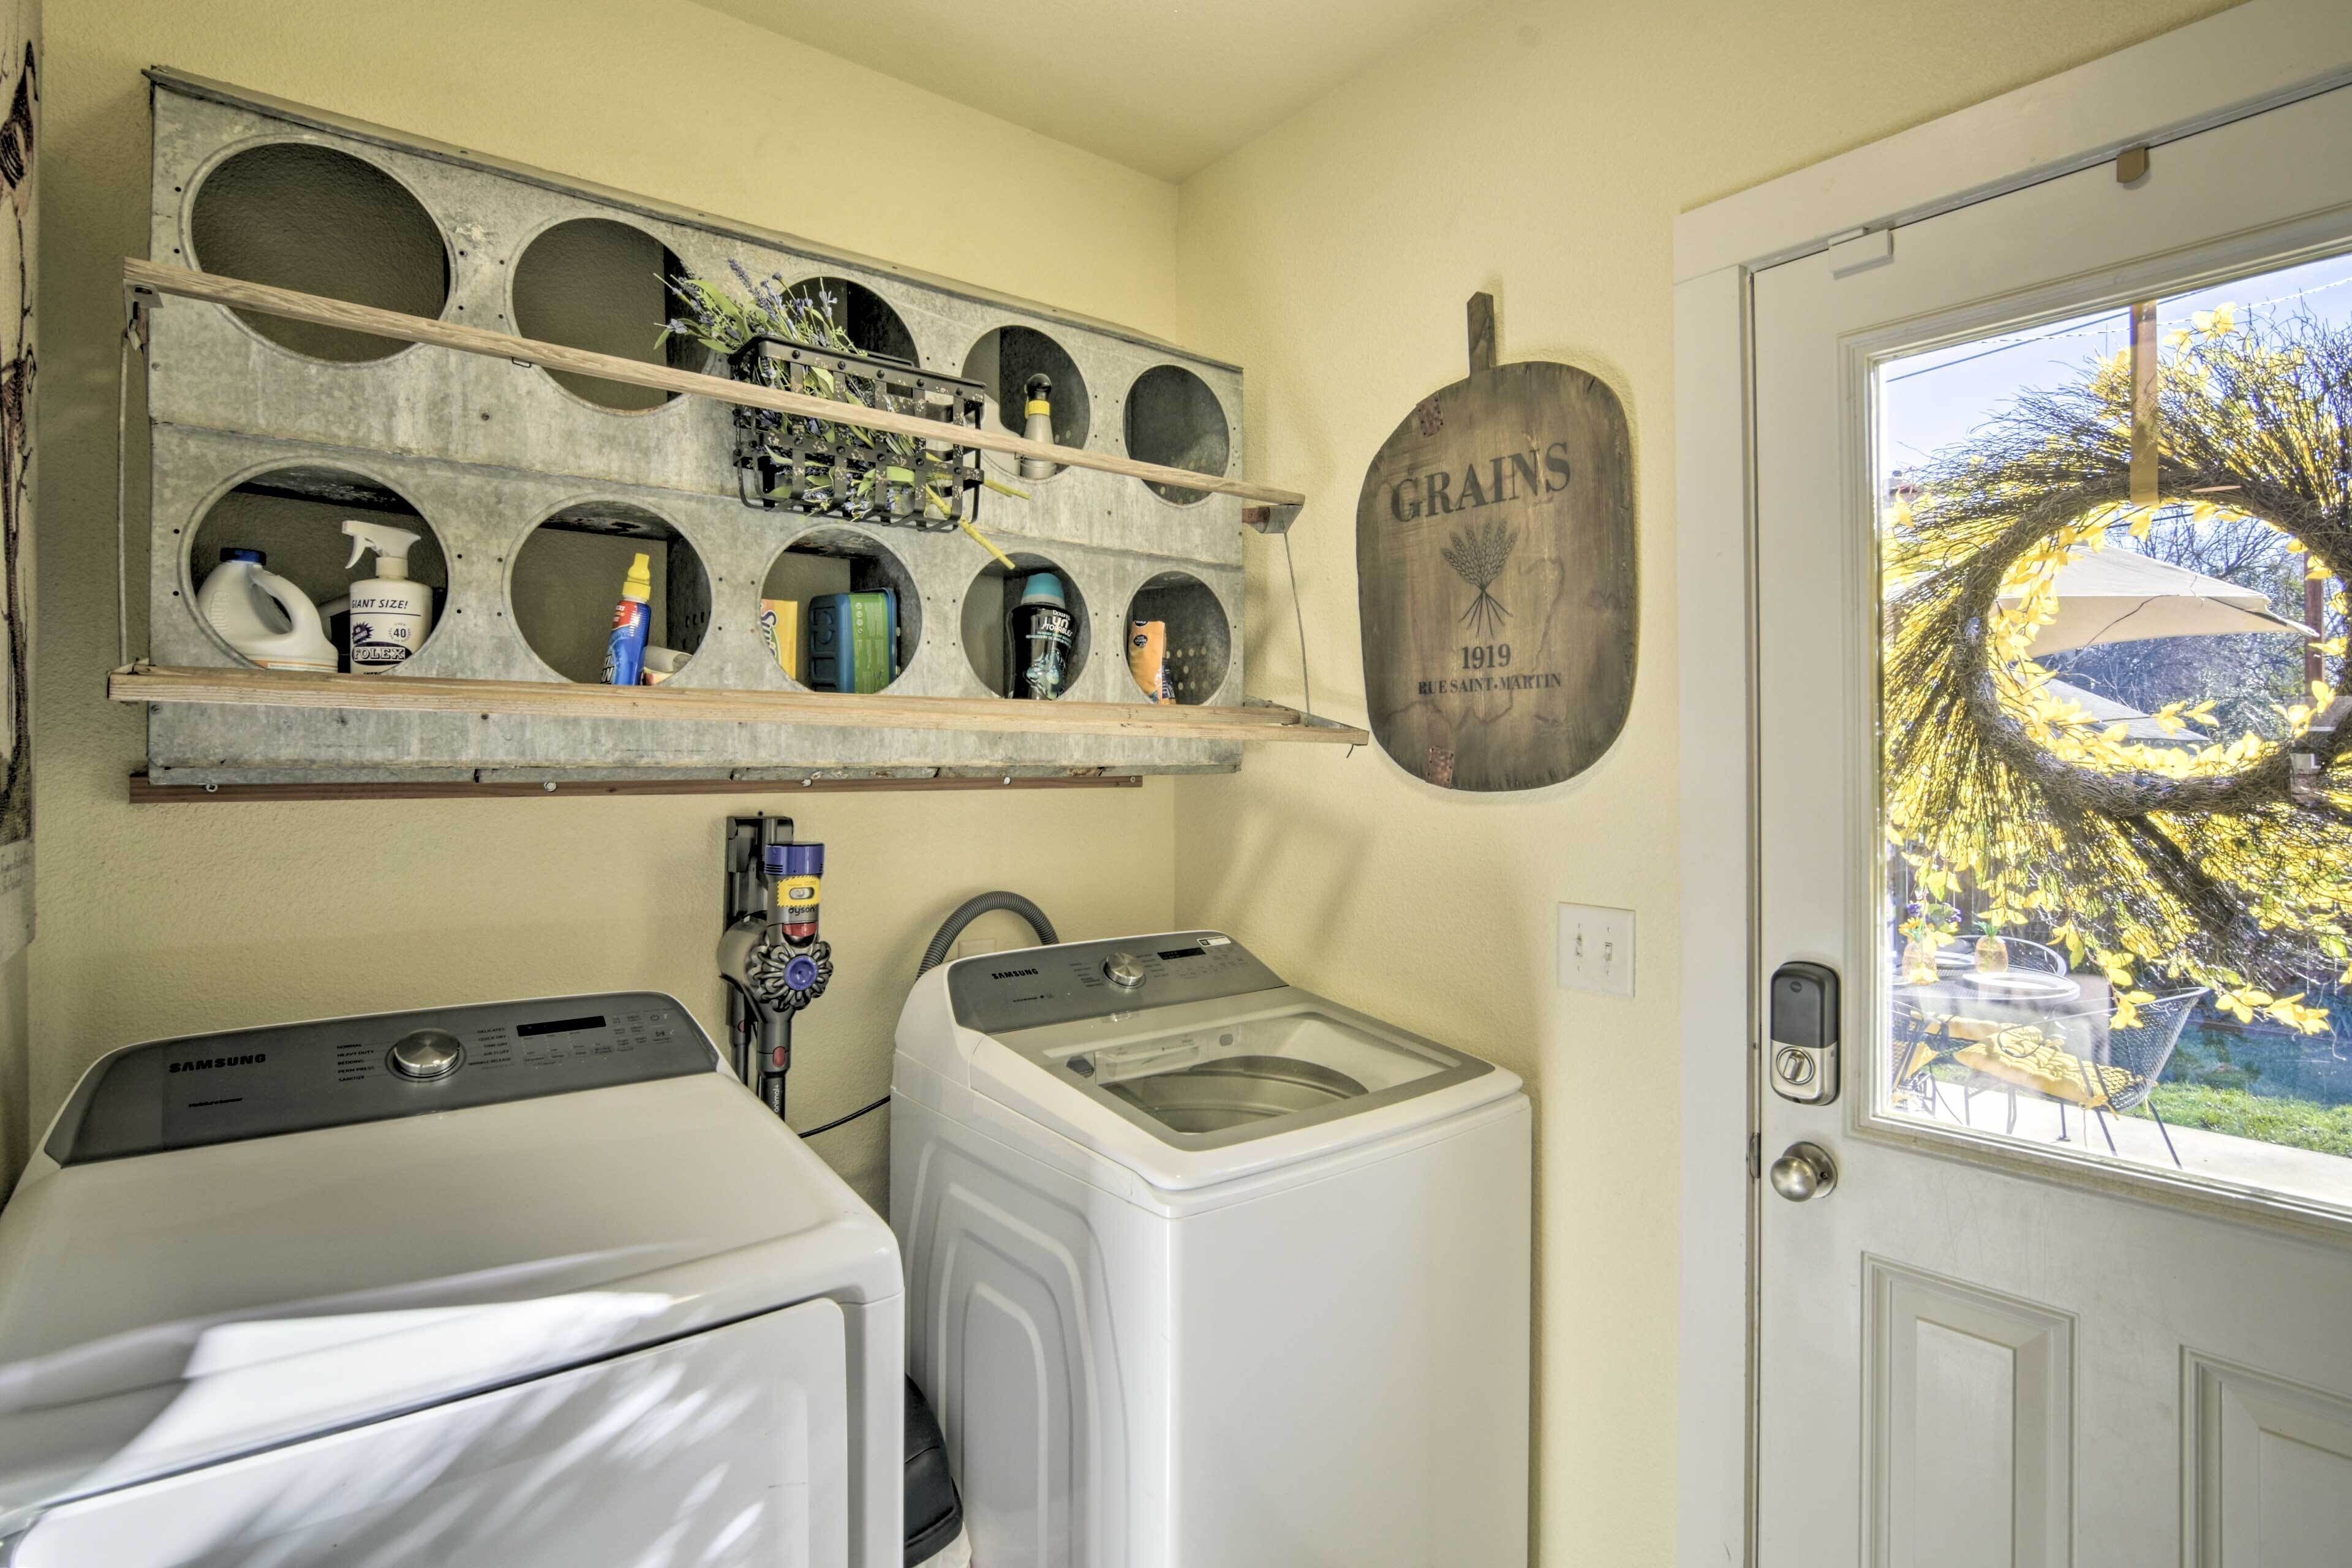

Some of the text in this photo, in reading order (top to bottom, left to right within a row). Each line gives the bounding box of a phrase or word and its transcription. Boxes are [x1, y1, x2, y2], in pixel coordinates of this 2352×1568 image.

[1390, 442, 1572, 522] GRAINS
[352, 599, 409, 609] GIANT SIZE!
[393, 628, 406, 638] 40
[354, 647, 404, 660] FOLEX
[1461, 644, 1512, 669] 1919
[1418, 680, 1447, 695] RUE
[788, 907, 815, 916] dyson
[992, 968, 1039, 980] SAMSUNG
[169, 1054, 266, 1072] SAMSUNG
